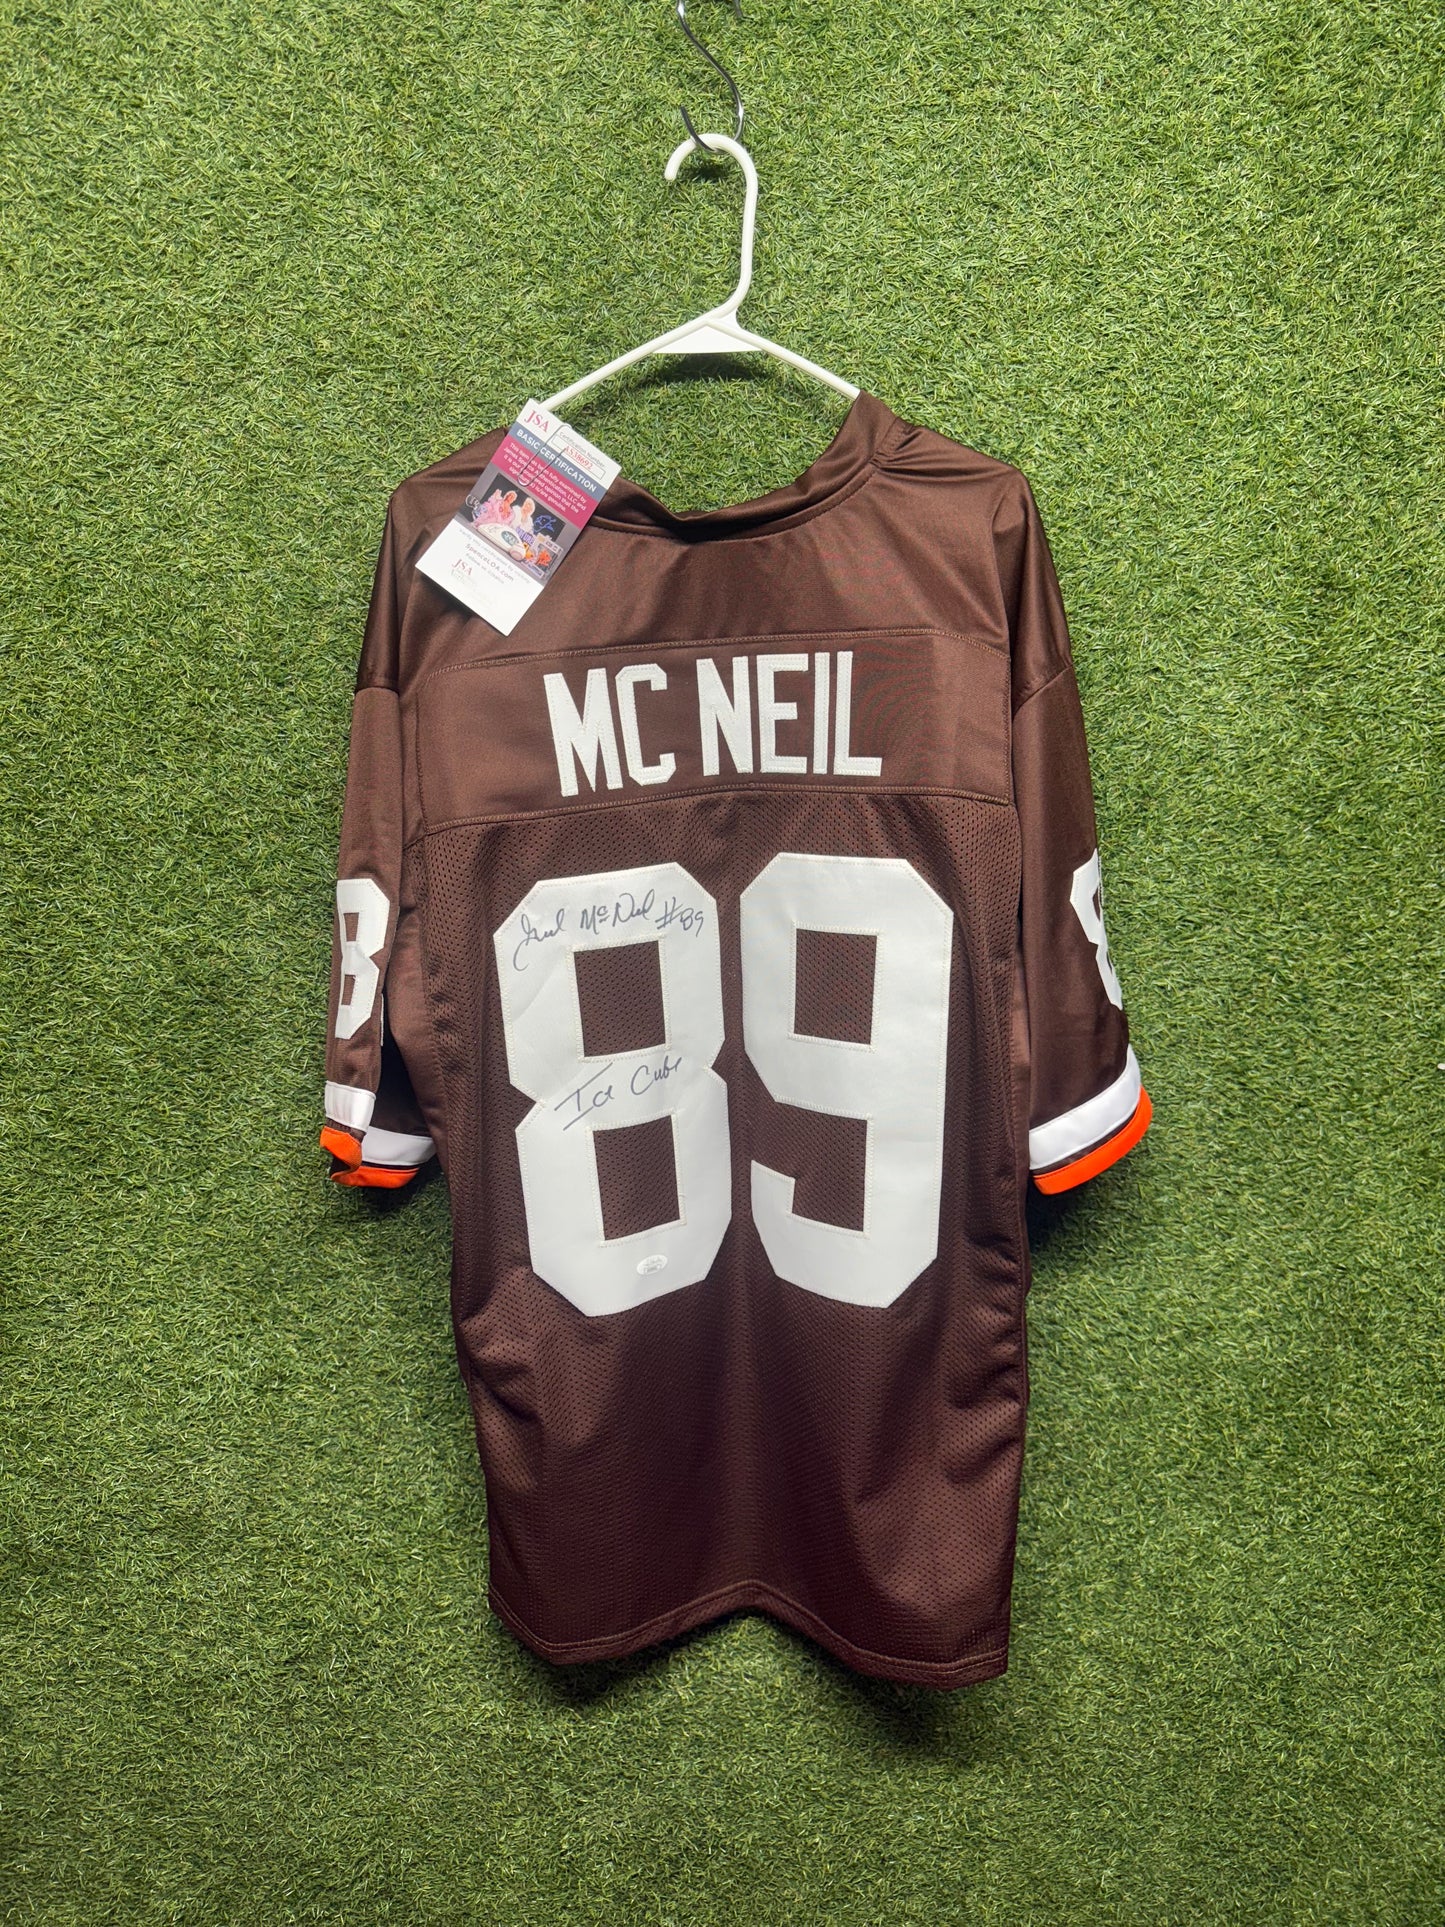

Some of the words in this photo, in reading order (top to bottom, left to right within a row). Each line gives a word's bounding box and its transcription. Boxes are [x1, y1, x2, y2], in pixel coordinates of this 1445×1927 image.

[523, 408, 552, 435] JSA
[515, 428, 541, 450] BASIC
[538, 446, 597, 492] CERTIFICATION
[451, 556, 475, 578] JSA
[543, 663, 677, 797] MC
[696, 650, 883, 778] NEIL
[493, 852, 954, 1317] 89
